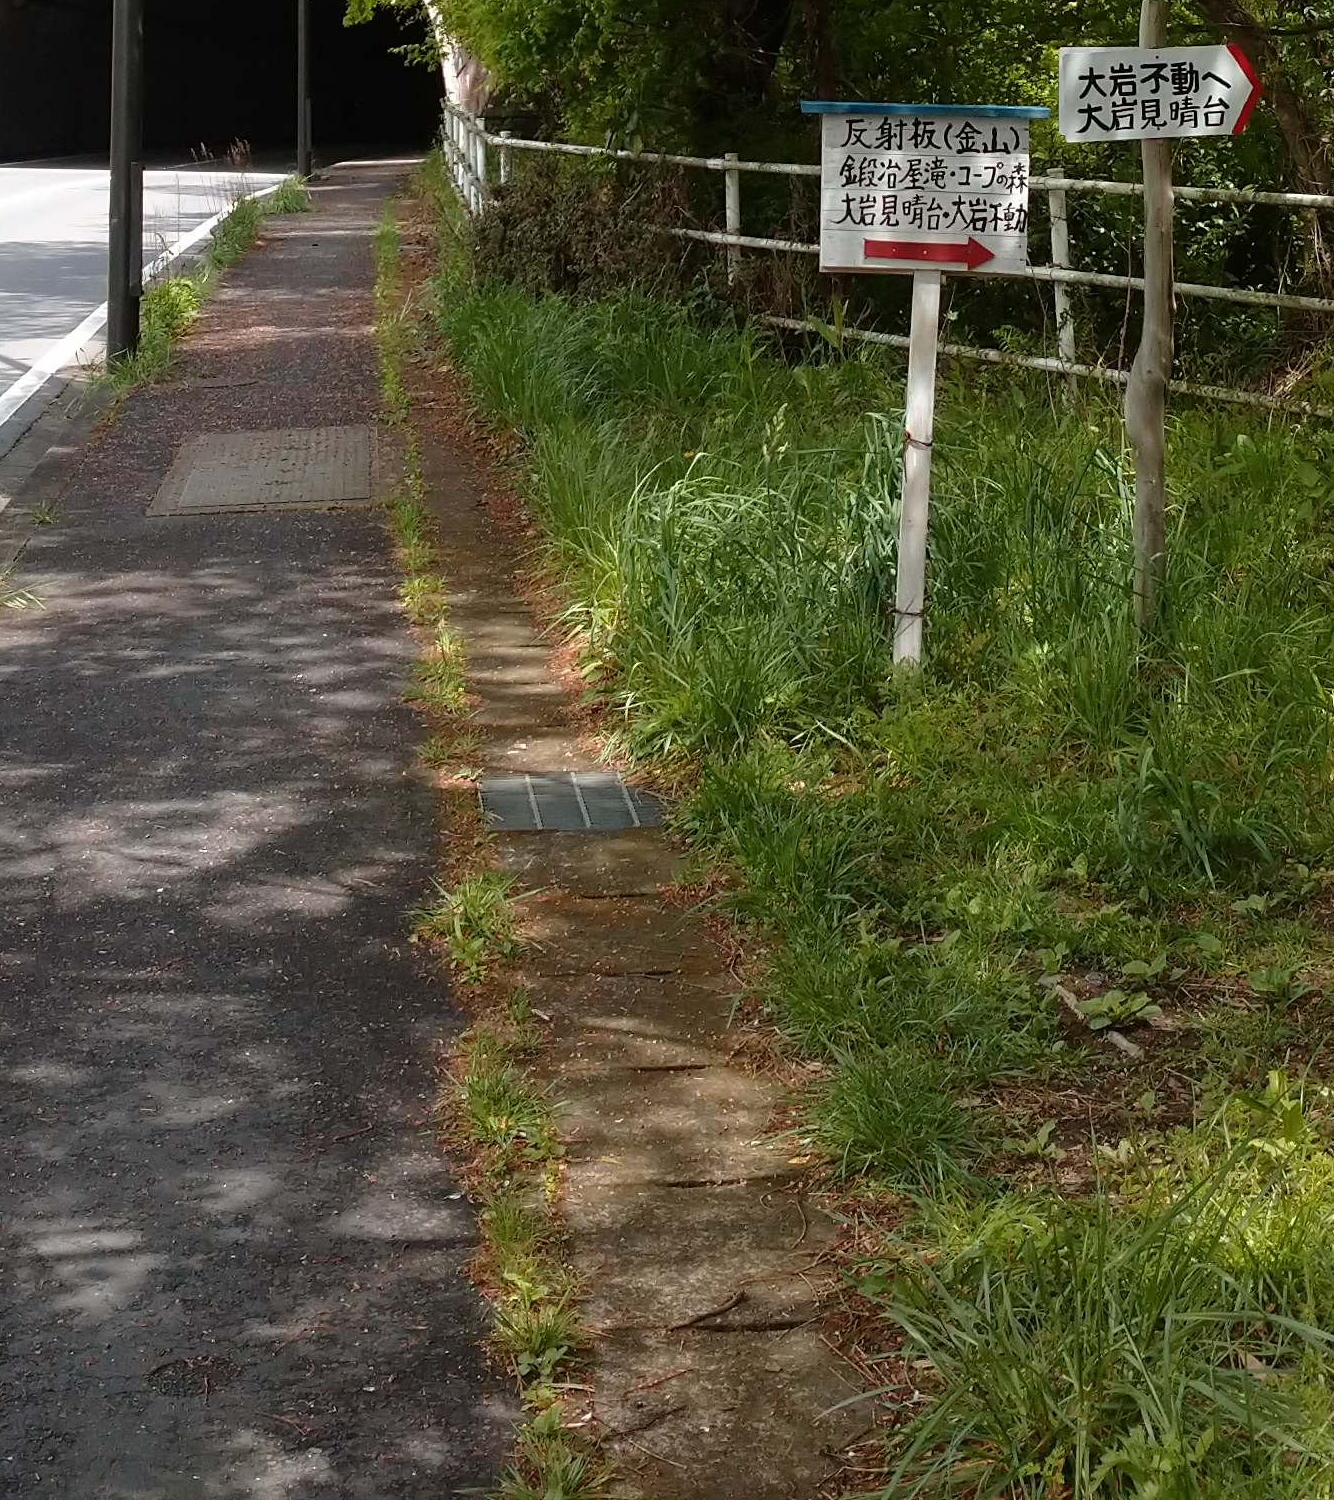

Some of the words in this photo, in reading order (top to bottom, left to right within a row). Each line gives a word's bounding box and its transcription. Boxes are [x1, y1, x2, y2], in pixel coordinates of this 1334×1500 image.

[1078, 62, 1231, 99] 大岩不動へ
[1075, 95, 1230, 133] 大岩見晴台
[831, 192, 1027, 233] 大岩見晴台・大岩不動
